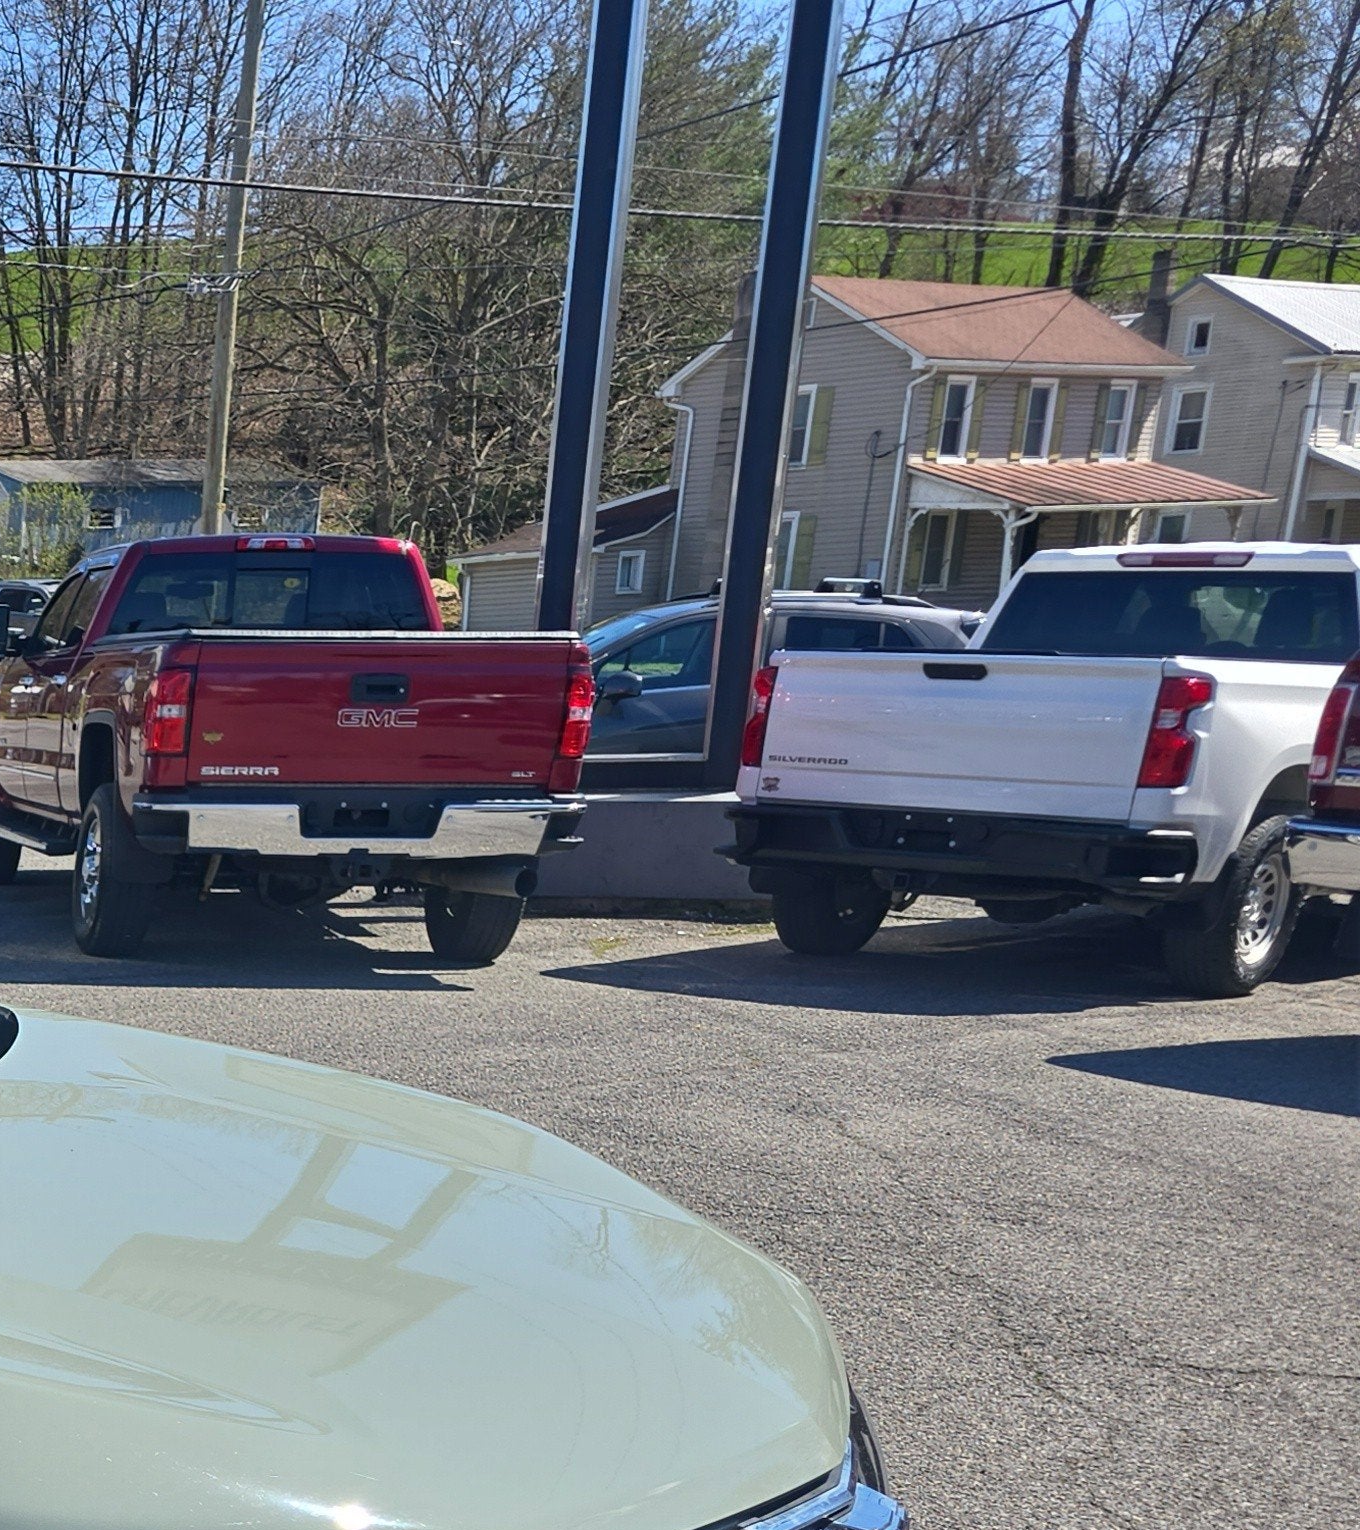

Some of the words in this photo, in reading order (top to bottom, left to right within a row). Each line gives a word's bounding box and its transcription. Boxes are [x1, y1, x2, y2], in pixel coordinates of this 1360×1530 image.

[337, 708, 419, 728] GMC
[768, 754, 848, 766] SILVERADO
[200, 766, 279, 776] SIERRA
